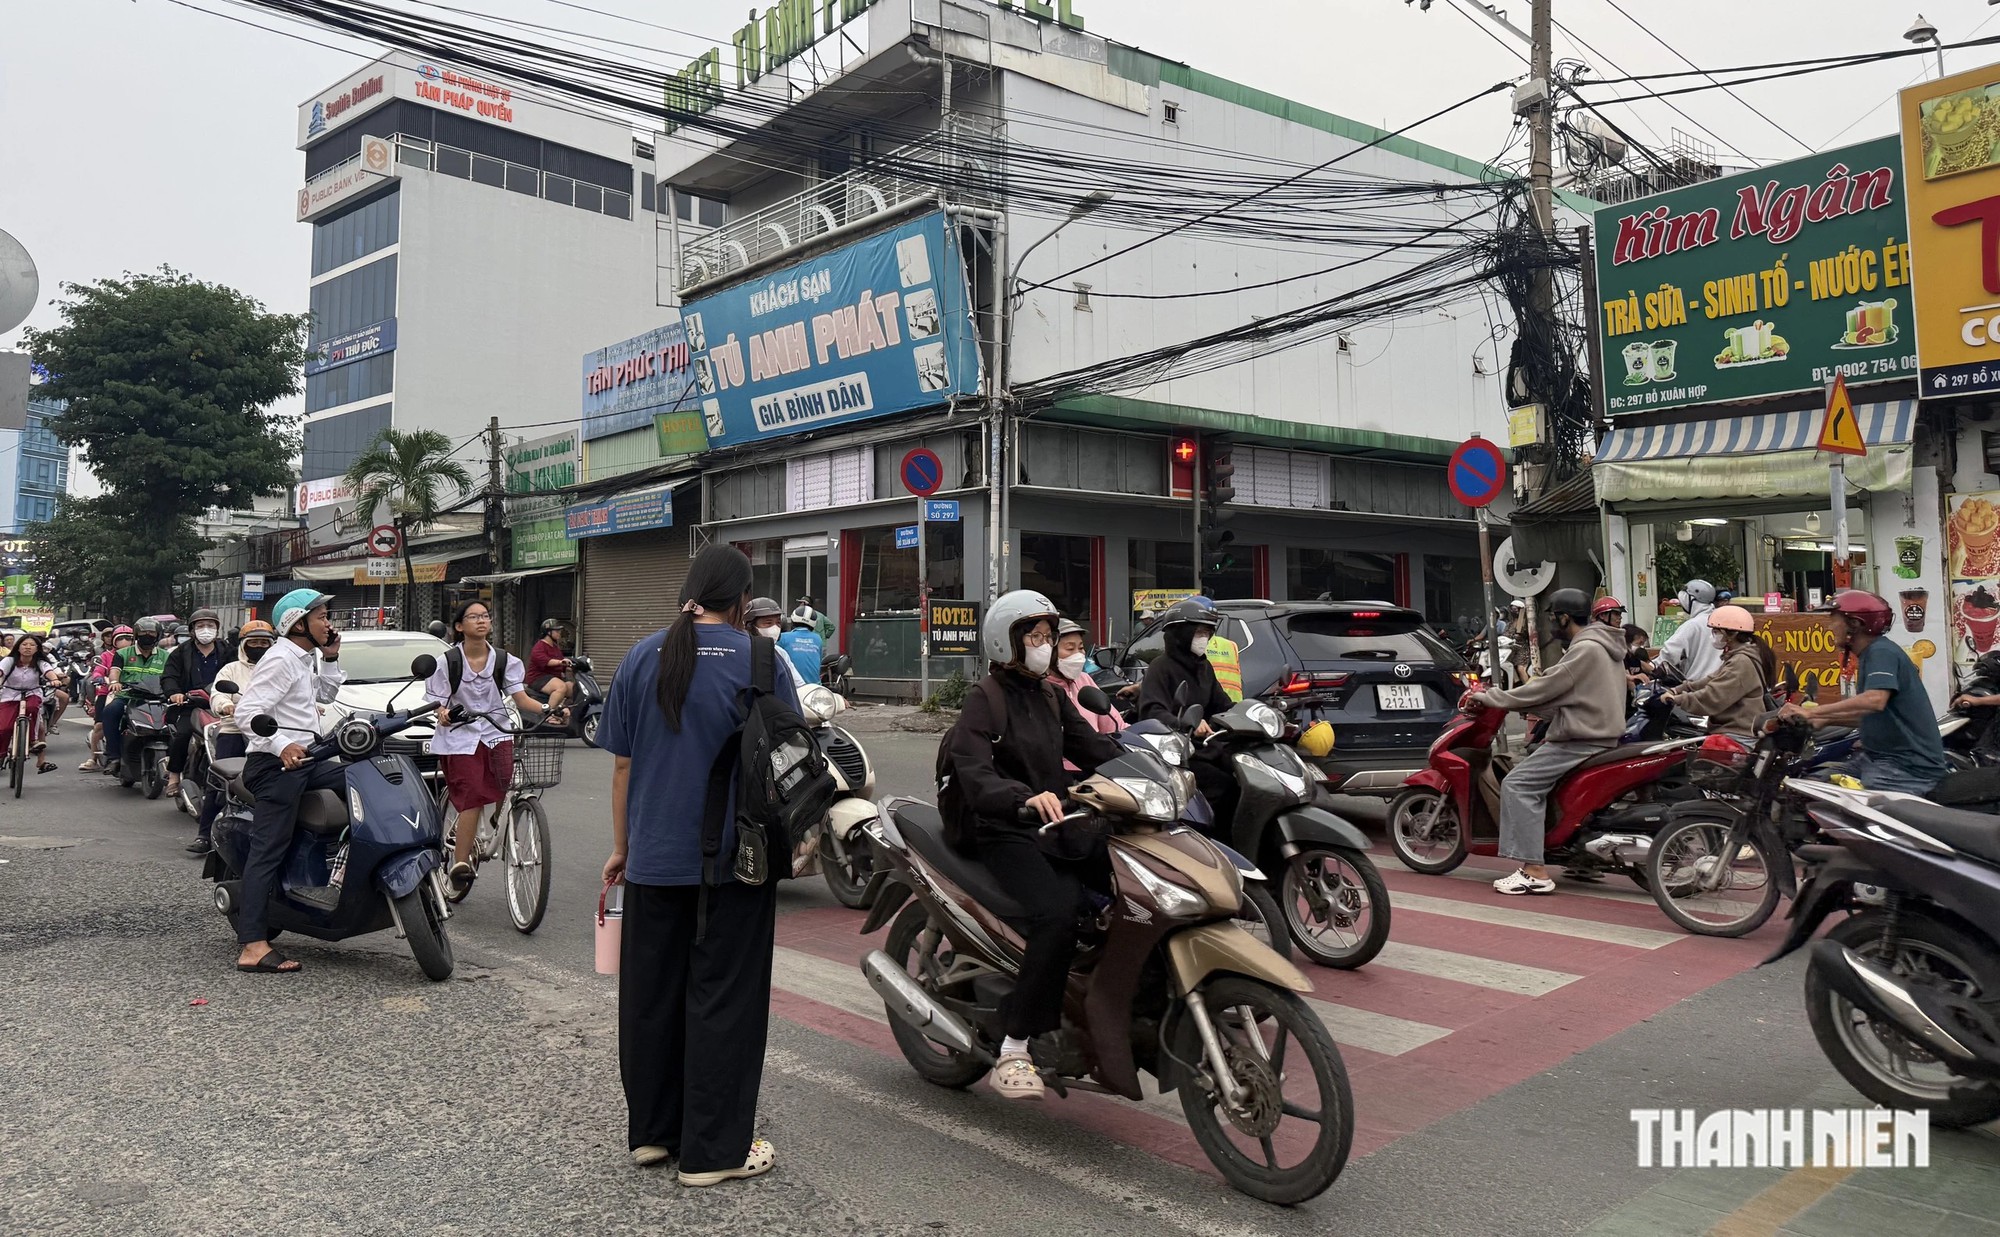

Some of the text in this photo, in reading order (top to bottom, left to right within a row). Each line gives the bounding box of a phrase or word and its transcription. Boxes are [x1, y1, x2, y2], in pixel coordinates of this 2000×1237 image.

[733, 8, 760, 91] TÚ
[352, 75, 384, 108] Building
[415, 81, 441, 103] TÂM
[443, 88, 474, 111] PHÁP
[311, 187, 332, 205] PUBLIC
[334, 179, 352, 195] BANK
[1612, 162, 1894, 267] Kim Ngân
[750, 269, 831, 317] KHÁCH SẠN
[1603, 290, 1642, 337] TRÀ
[1644, 283, 1687, 330] SỮA
[1703, 273, 1756, 319] SINH
[1760, 253, 1789, 308] TỐ
[1809, 244, 1878, 301] NƯỚC
[332, 349, 344, 363] PVI
[345, 340, 360, 358] THỦ
[361, 336, 380, 352] ĐỨC
[710, 333, 746, 390] TÚ
[749, 320, 811, 382] ANH
[811, 289, 901, 365] PHÁT
[586, 366, 613, 396] TÂN
[616, 350, 655, 387] PHÚC
[1871, 357, 1897, 374] 754
[1951, 374, 1968, 387] 297
[1972, 366, 1988, 384] ĐỖ
[758, 382, 866, 427] GIÁ BÌNH DÂN
[1610, 396, 1625, 409] ĐC:
[1627, 394, 1644, 407] 297
[1660, 387, 1686, 402] XUÂN
[1688, 384, 1707, 400] HỢP
[309, 489, 331, 503] PUBLIC
[930, 510, 941, 519] SỐ
[932, 607, 977, 626] HOTEL
[932, 628, 977, 642] TÚ ANH PHÁT
[1753, 620, 1836, 653] Ố NƯỚC
[1385, 697, 1420, 709] 212.11
[1391, 685, 1411, 697] 51M
[1123, 914, 1153, 926] HONDA
